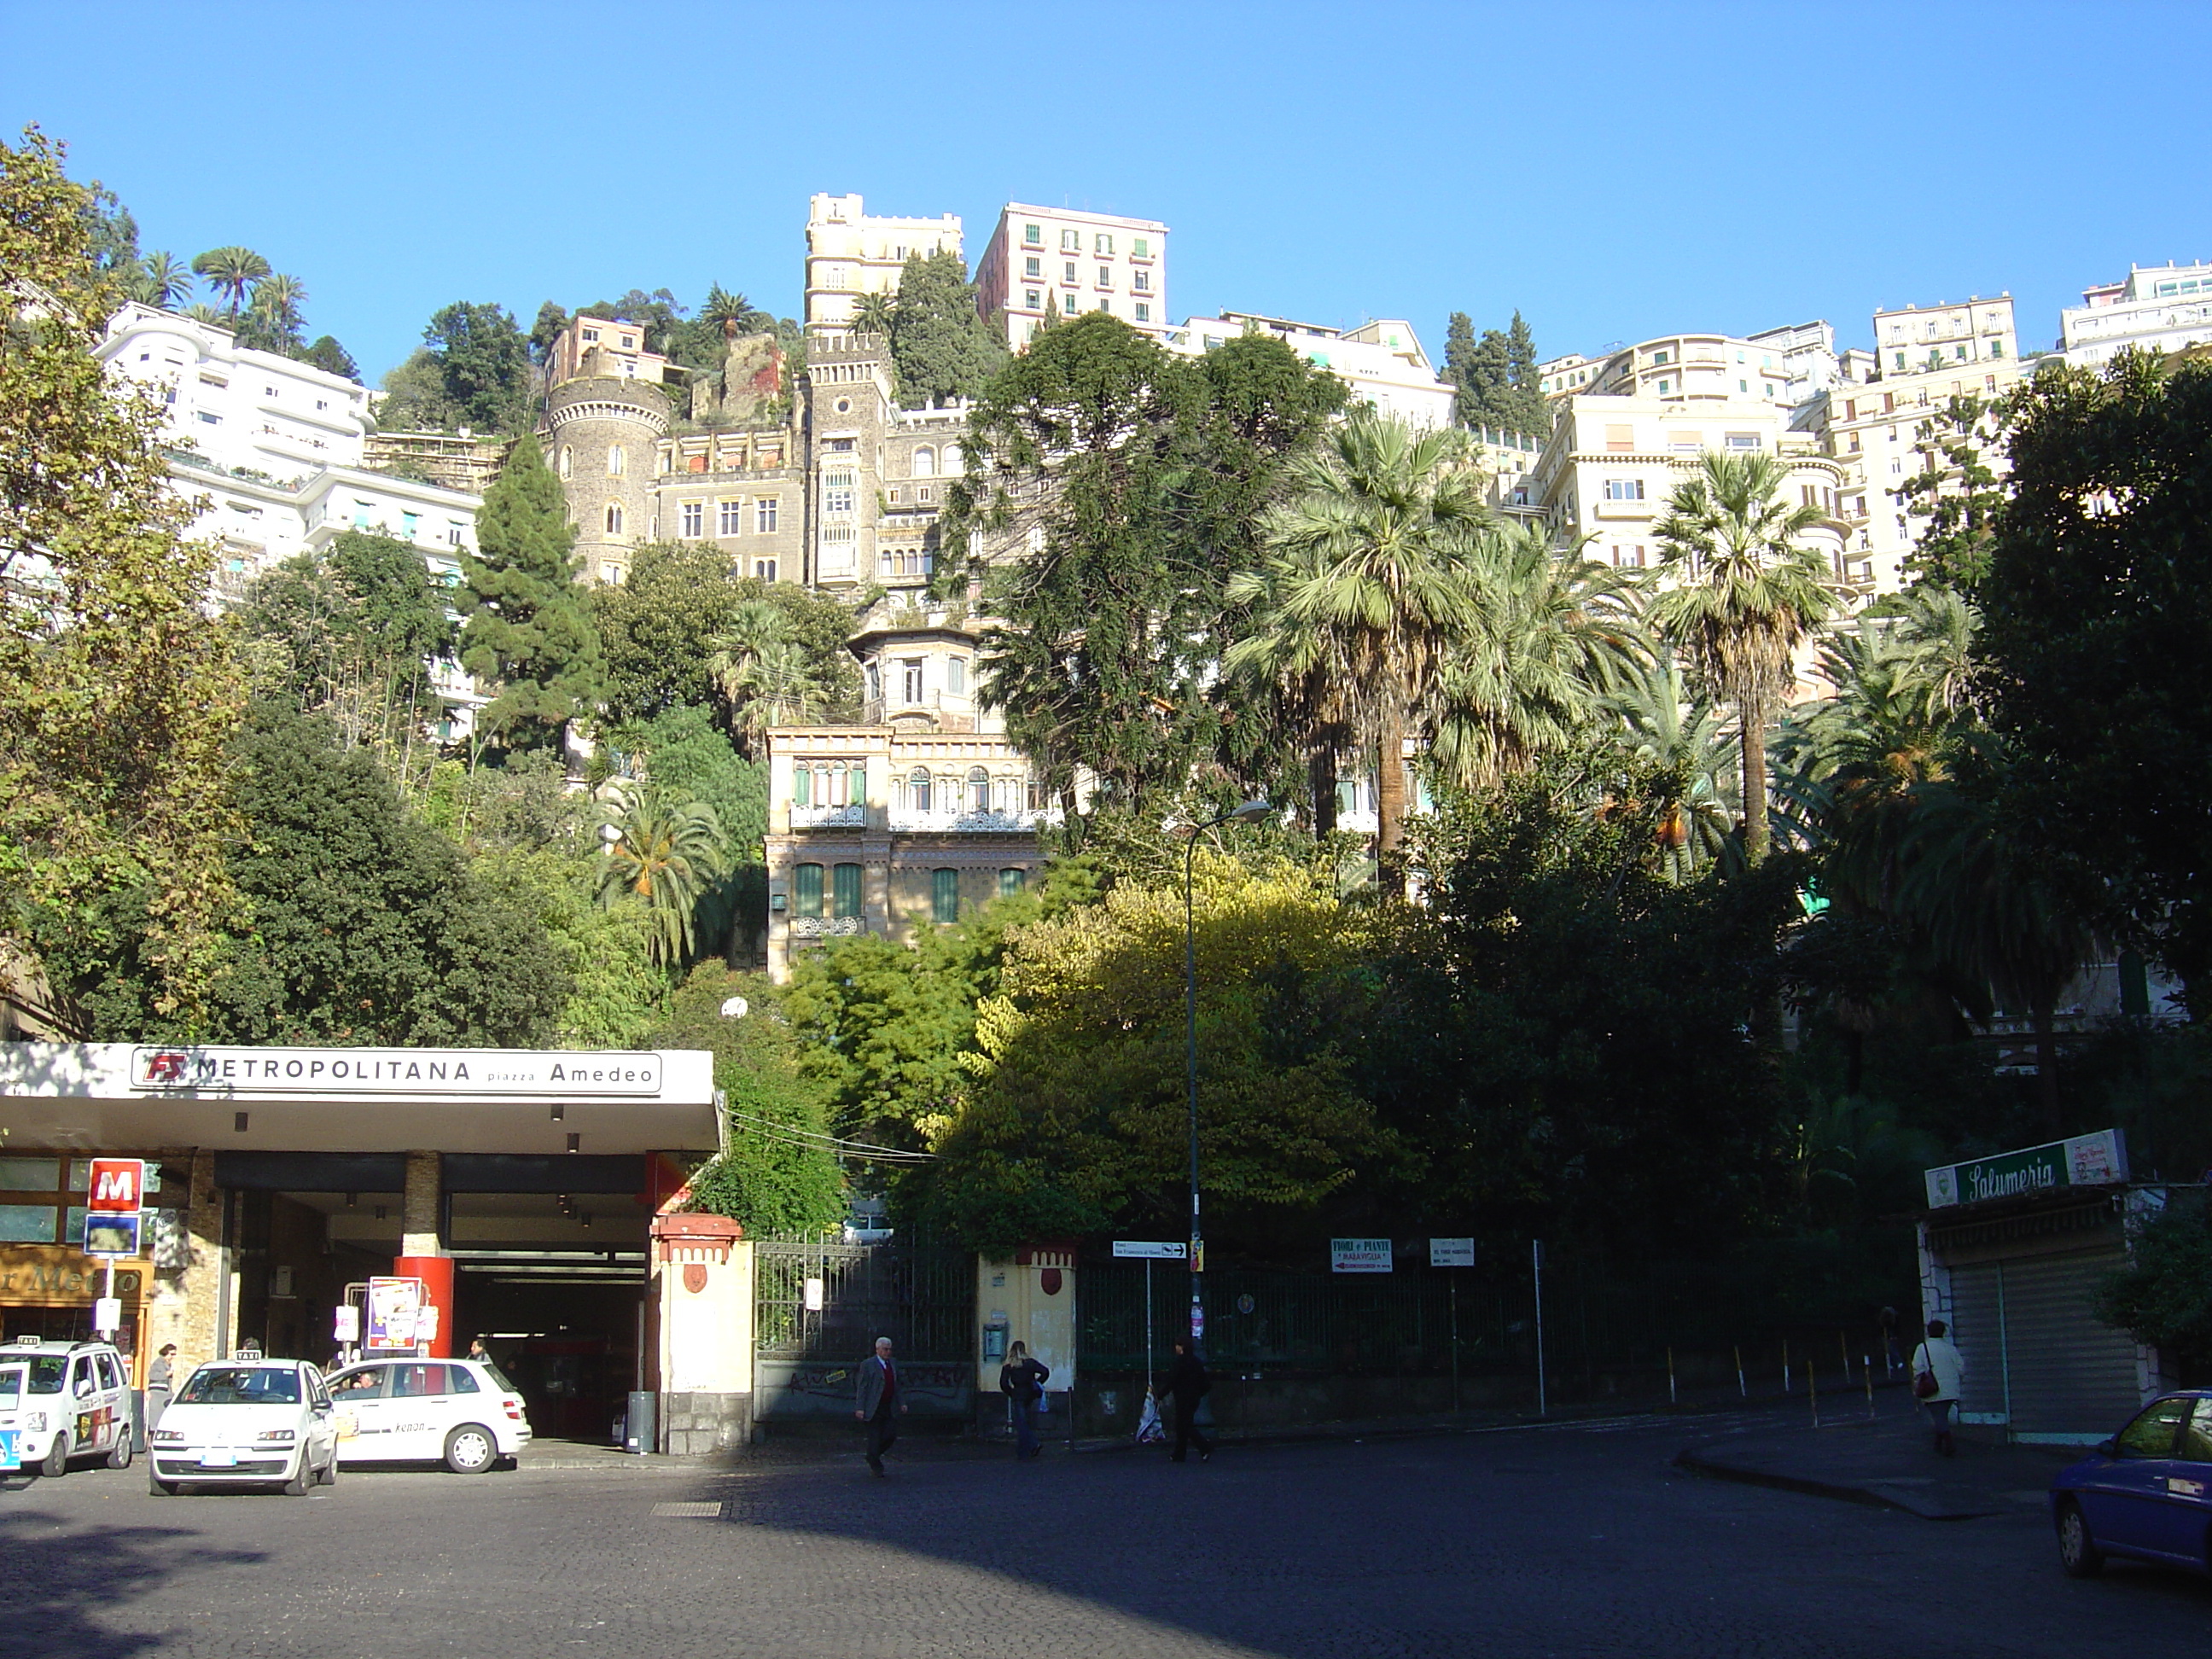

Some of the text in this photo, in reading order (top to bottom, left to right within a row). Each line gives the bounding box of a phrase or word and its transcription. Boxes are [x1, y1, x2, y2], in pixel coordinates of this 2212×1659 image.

[197, 1058, 469, 1080] METROPOLITANA
[488, 1072, 534, 1082] piazza
[550, 1063, 652, 1082] Amedeo
[96, 1172, 133, 1200] M
[1969, 1157, 2056, 1202] Salumeria
